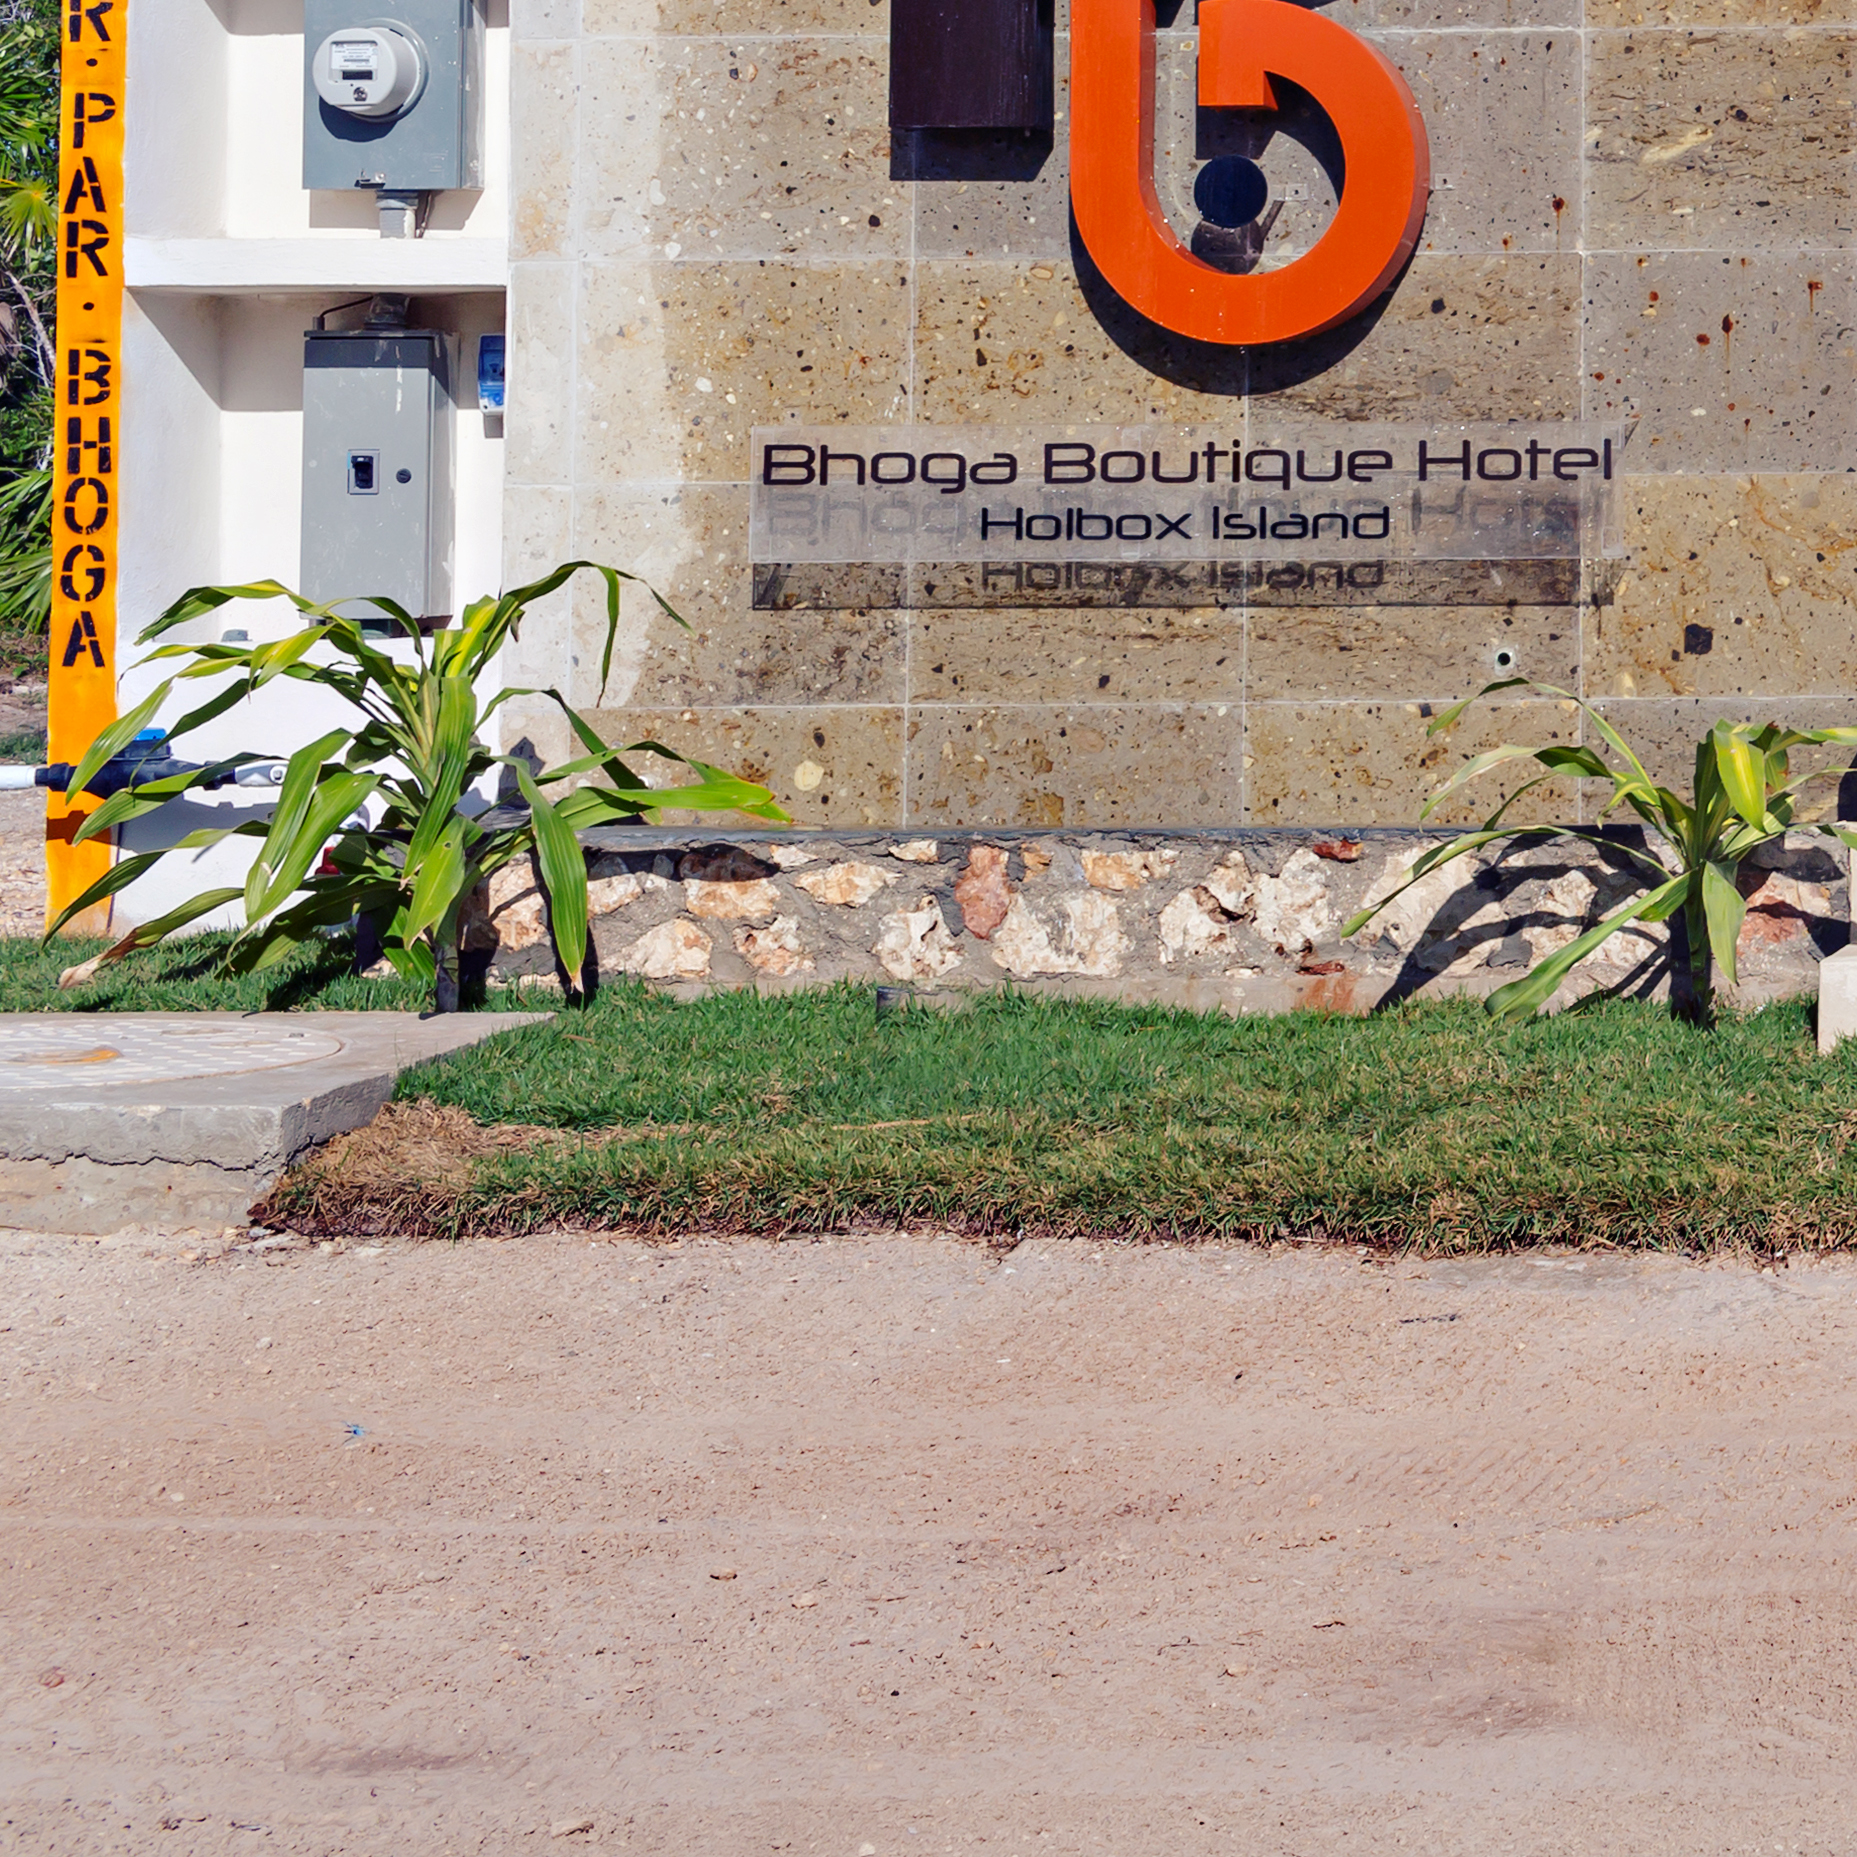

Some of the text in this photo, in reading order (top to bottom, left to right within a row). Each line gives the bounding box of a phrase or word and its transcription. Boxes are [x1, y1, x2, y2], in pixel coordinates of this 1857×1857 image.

[63, 92, 116, 278] PAR
[60, 349, 112, 668] BHOGA
[763, 439, 1612, 494] Bhoga Boutique Hotel
[981, 506, 1390, 541] Holbox Island
